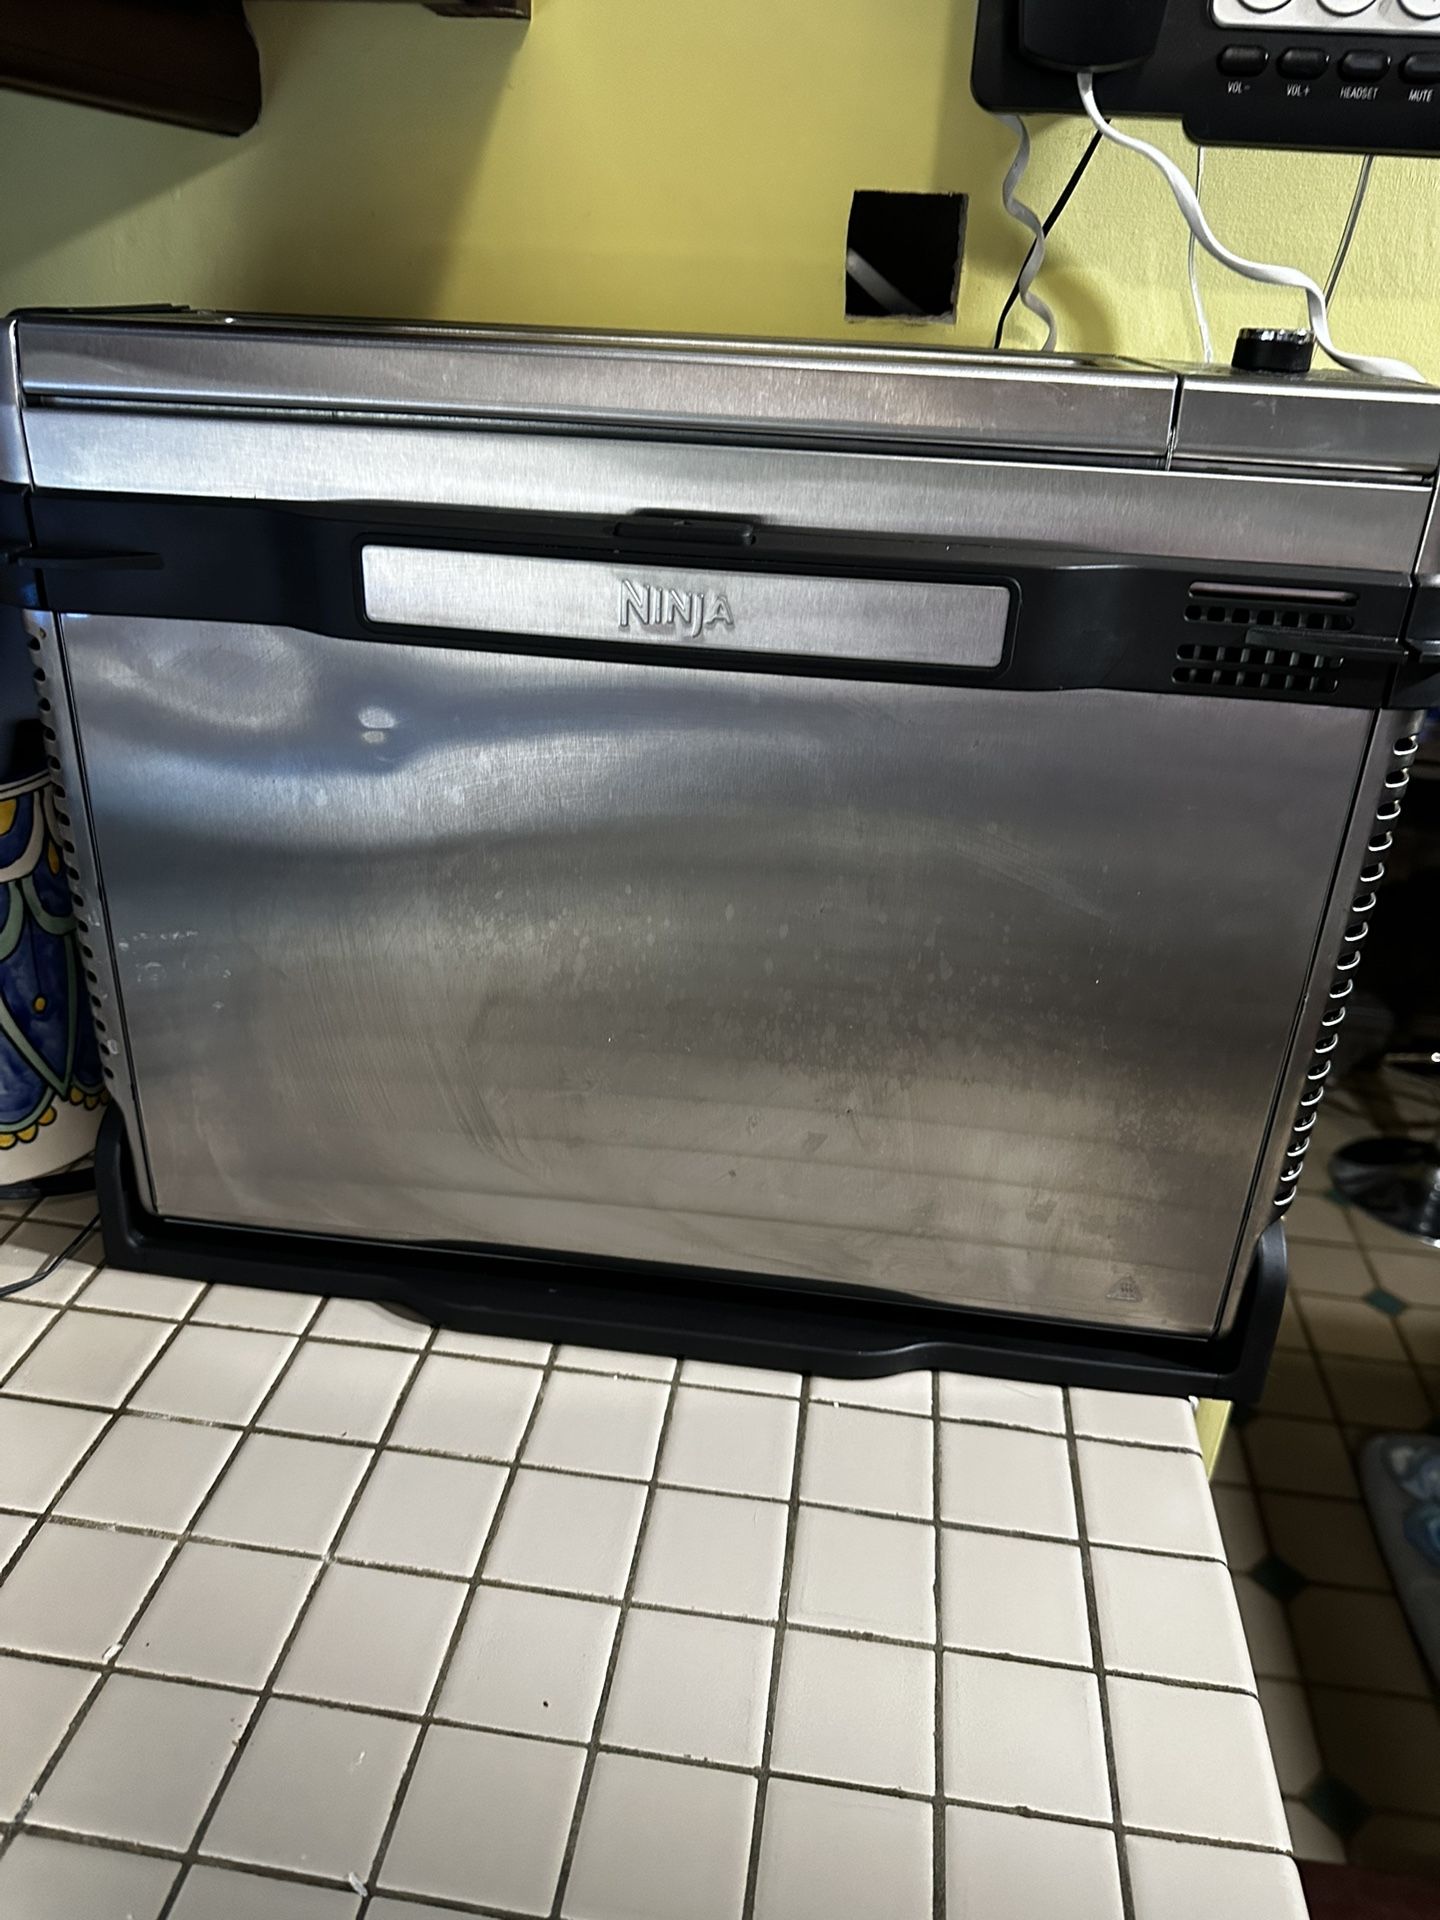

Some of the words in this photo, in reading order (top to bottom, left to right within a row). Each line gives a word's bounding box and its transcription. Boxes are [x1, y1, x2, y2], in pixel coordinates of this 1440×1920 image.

[1340, 86, 1379, 100] HEADSET
[1408, 89, 1433, 102] MUTE
[619, 578, 735, 639] NINJA
